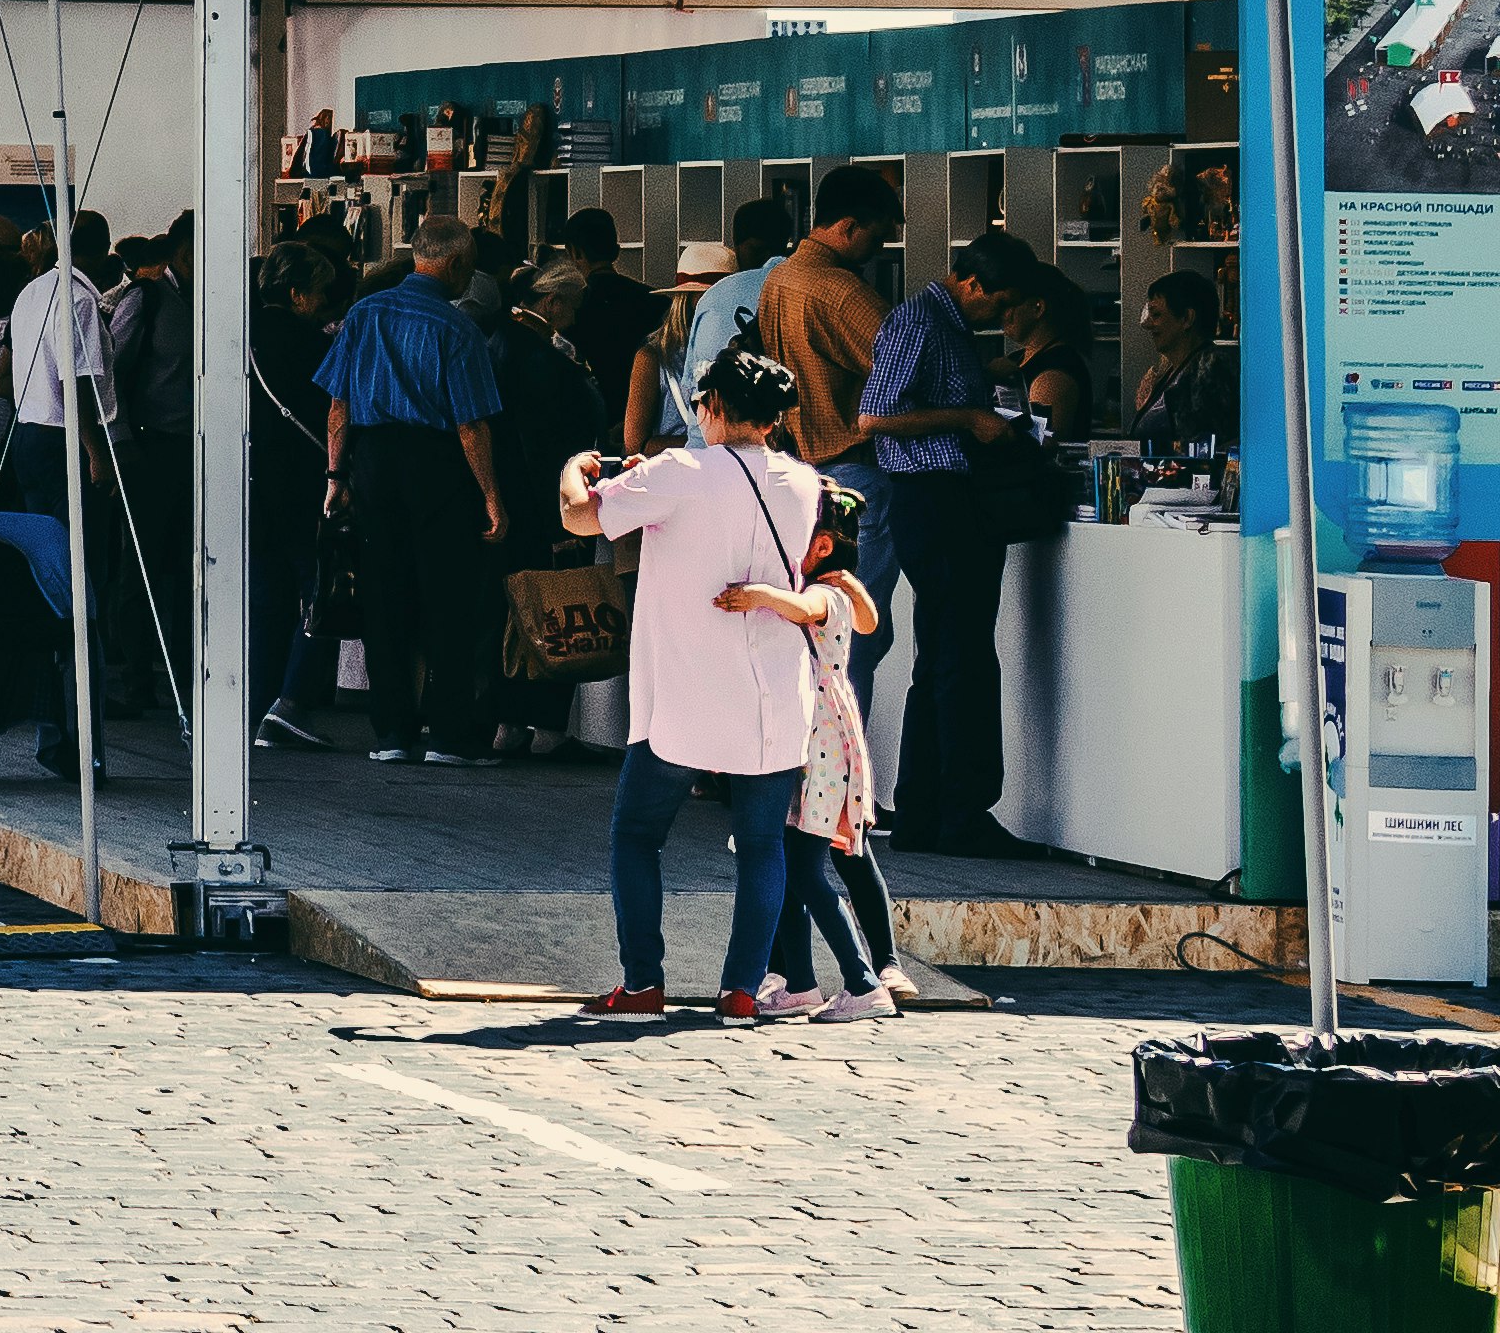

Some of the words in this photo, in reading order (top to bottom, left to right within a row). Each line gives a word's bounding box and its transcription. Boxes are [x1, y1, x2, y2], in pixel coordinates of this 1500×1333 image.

[1339, 201, 1357, 211] НА
[1361, 200, 1422, 213] КРАСНОЙ
[1426, 202, 1494, 215] ПЛОЩАДИ
[1442, 820, 1464, 832] ЛЕС
